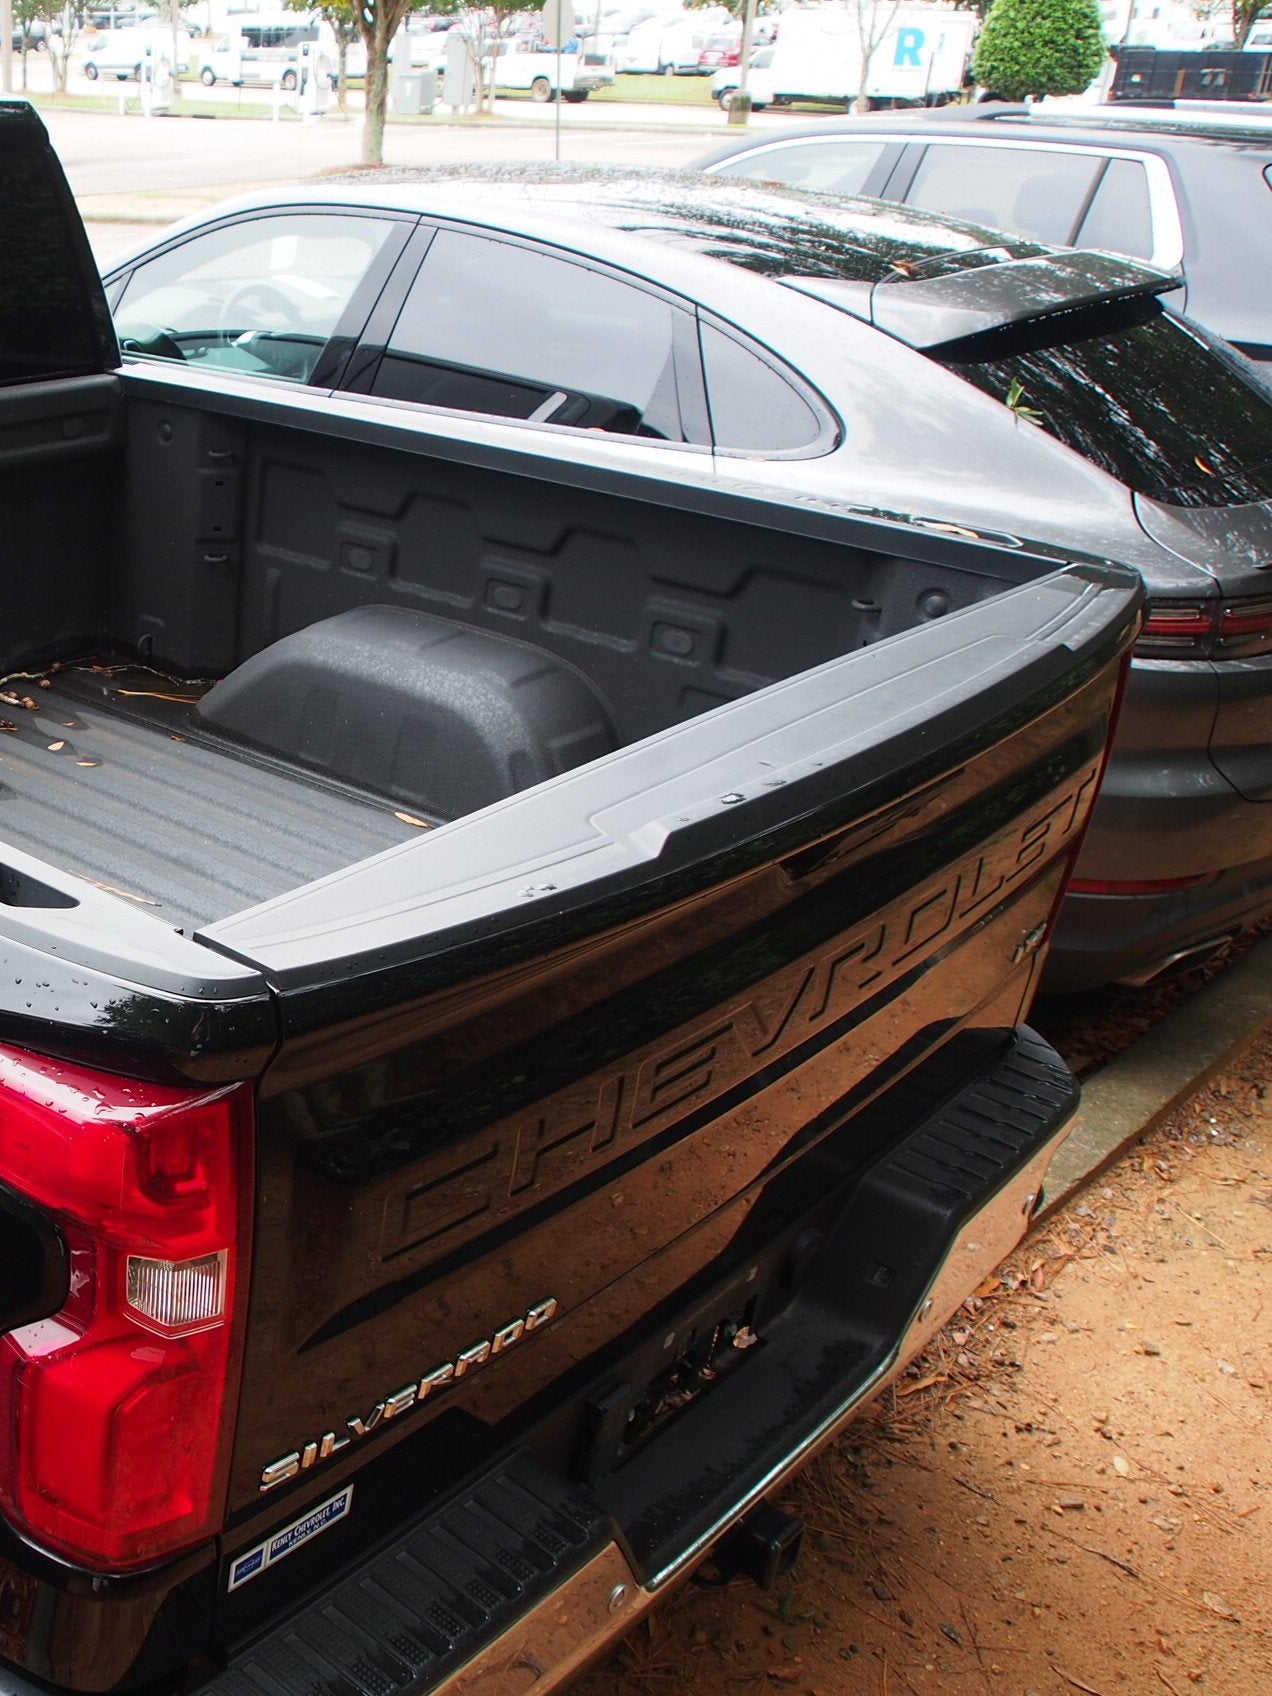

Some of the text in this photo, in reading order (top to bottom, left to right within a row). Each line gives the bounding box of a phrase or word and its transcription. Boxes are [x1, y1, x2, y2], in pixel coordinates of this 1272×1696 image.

[893, 27, 926, 67] R
[380, 767, 1097, 1263] CHEVROLET
[259, 1297, 557, 1492] SILVERADO
[271, 1531, 293, 1552] KENLY
